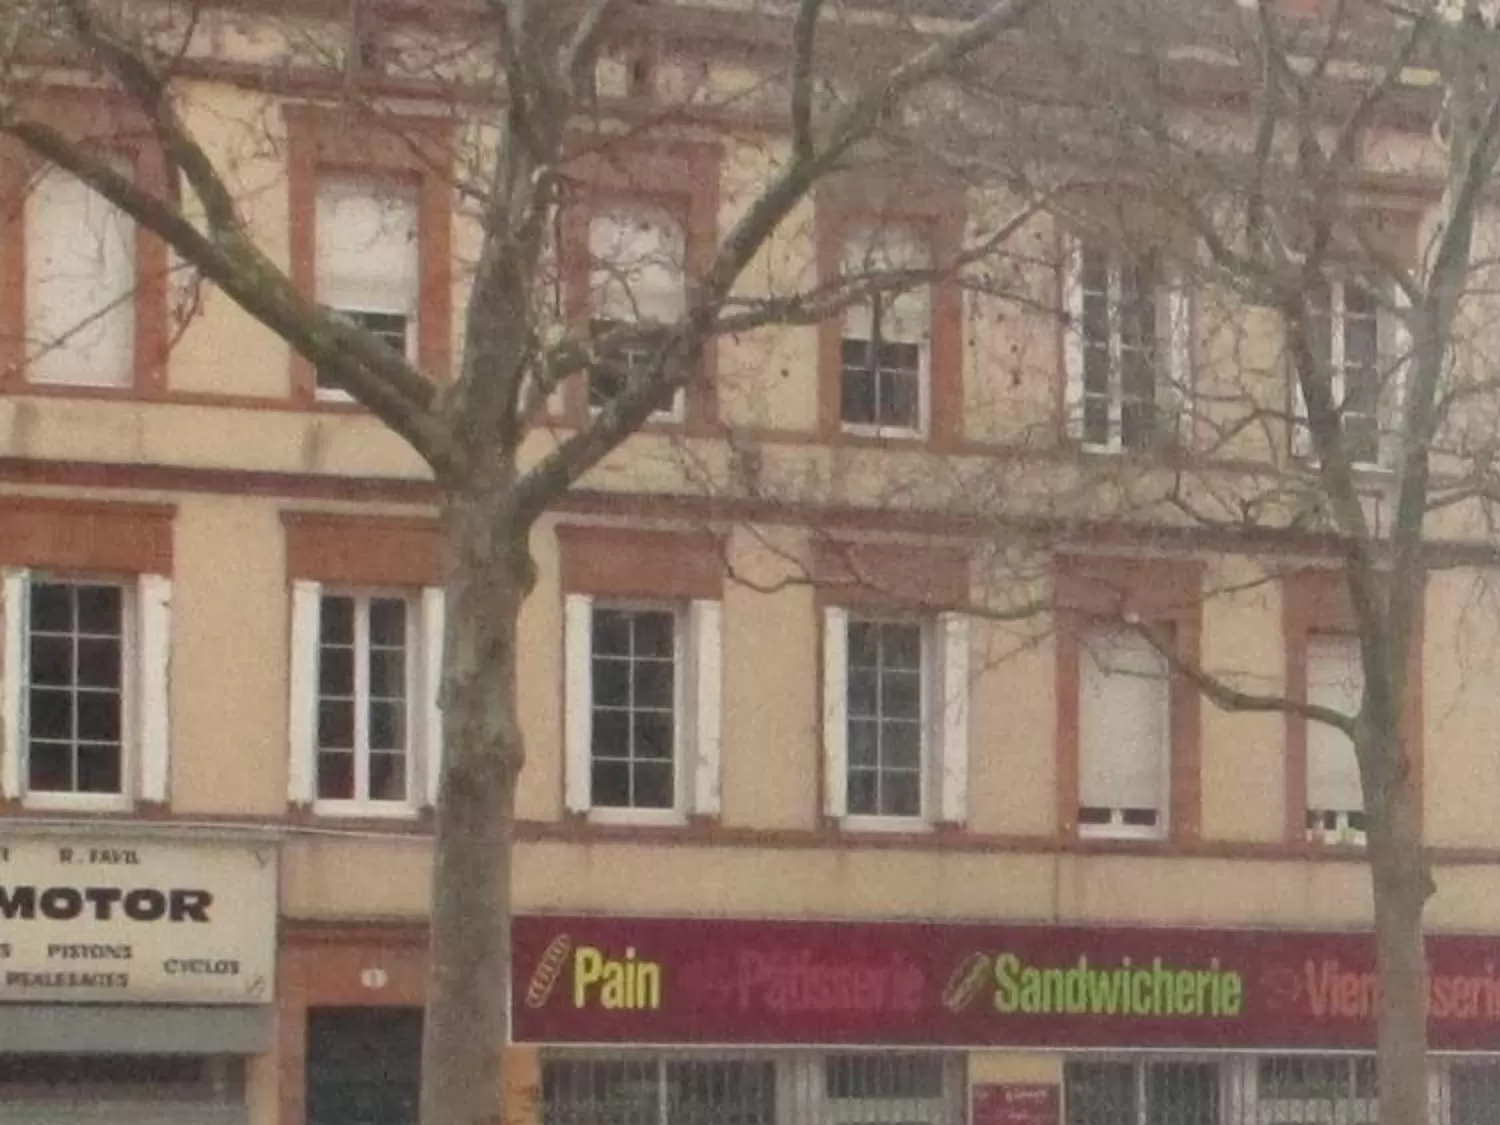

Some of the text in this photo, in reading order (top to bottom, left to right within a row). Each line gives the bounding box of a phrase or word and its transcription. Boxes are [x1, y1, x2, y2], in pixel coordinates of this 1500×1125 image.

[47, 943, 133, 960] PISTONS
[162, 958, 241, 976] CYCLOS
[573, 946, 661, 1010] Pain
[993, 952, 1243, 1017] Sandwicherie
